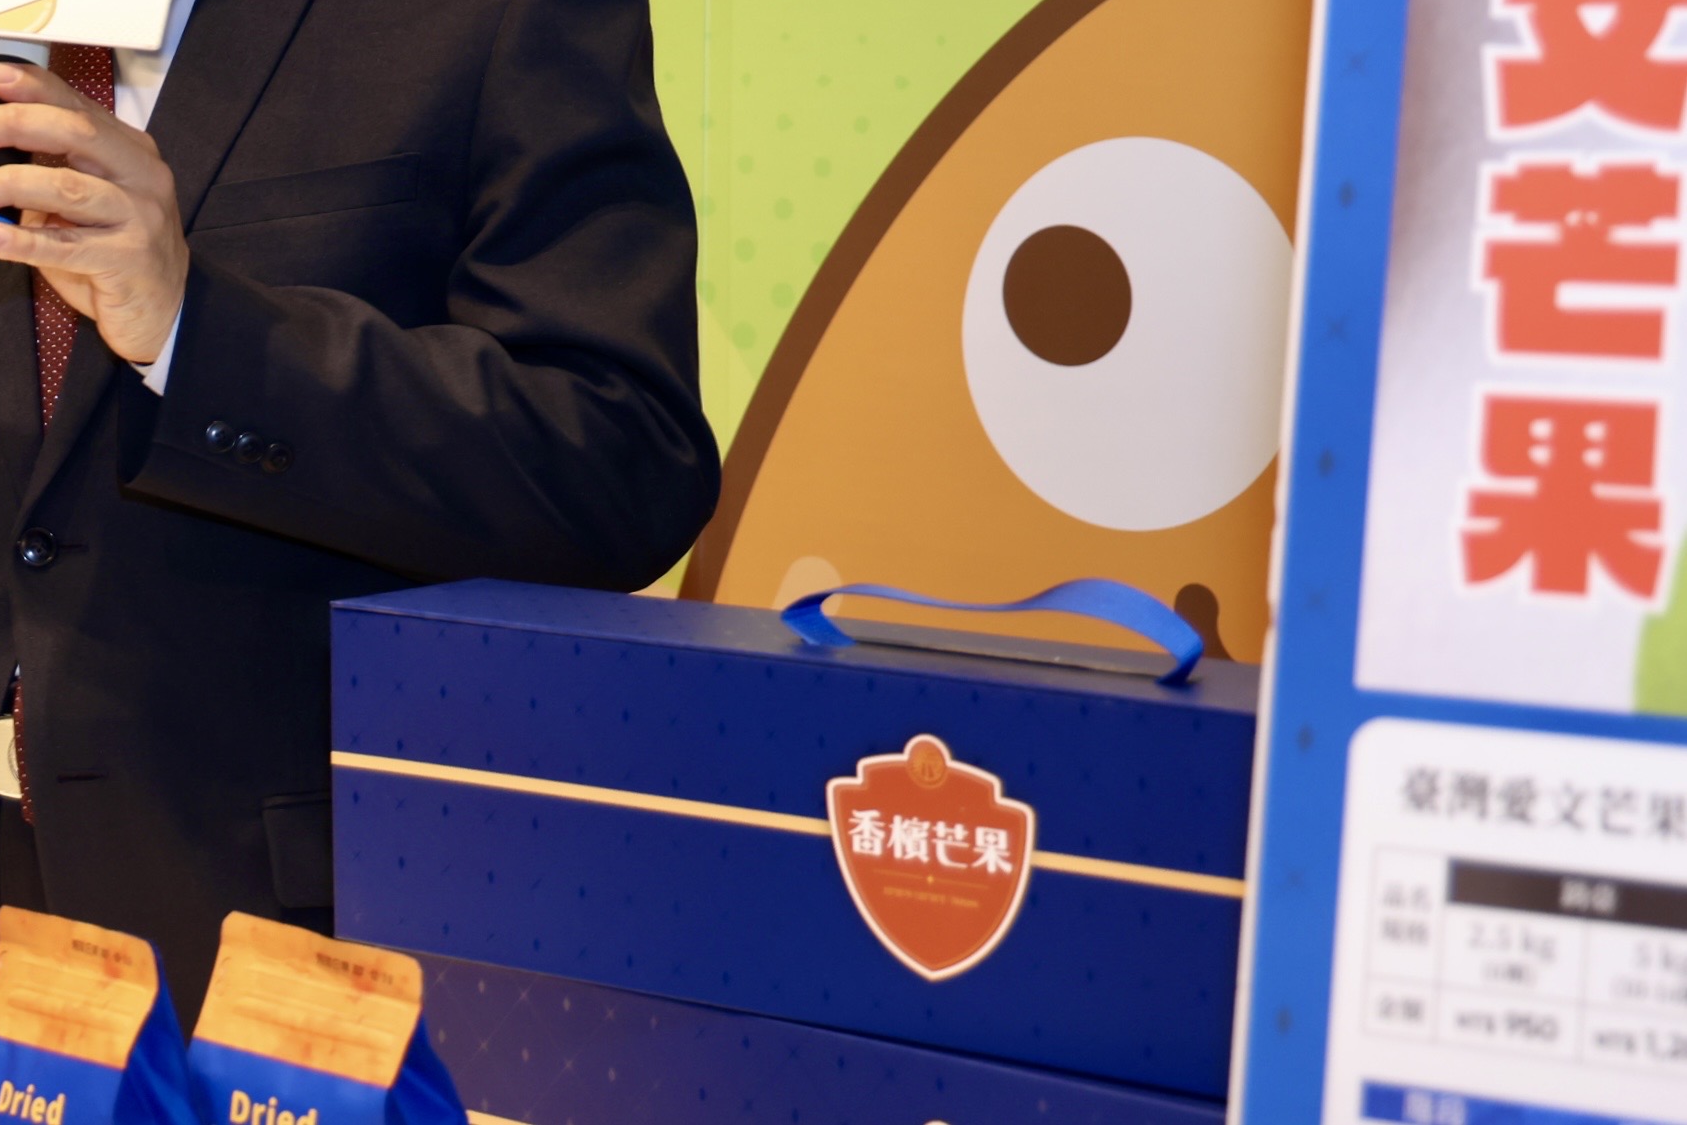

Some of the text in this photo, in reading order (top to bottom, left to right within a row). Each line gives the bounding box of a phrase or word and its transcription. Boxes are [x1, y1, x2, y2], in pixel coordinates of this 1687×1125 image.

[847, 808, 1013, 874] 香檳芒果
[229, 1090, 318, 1125] Dried
